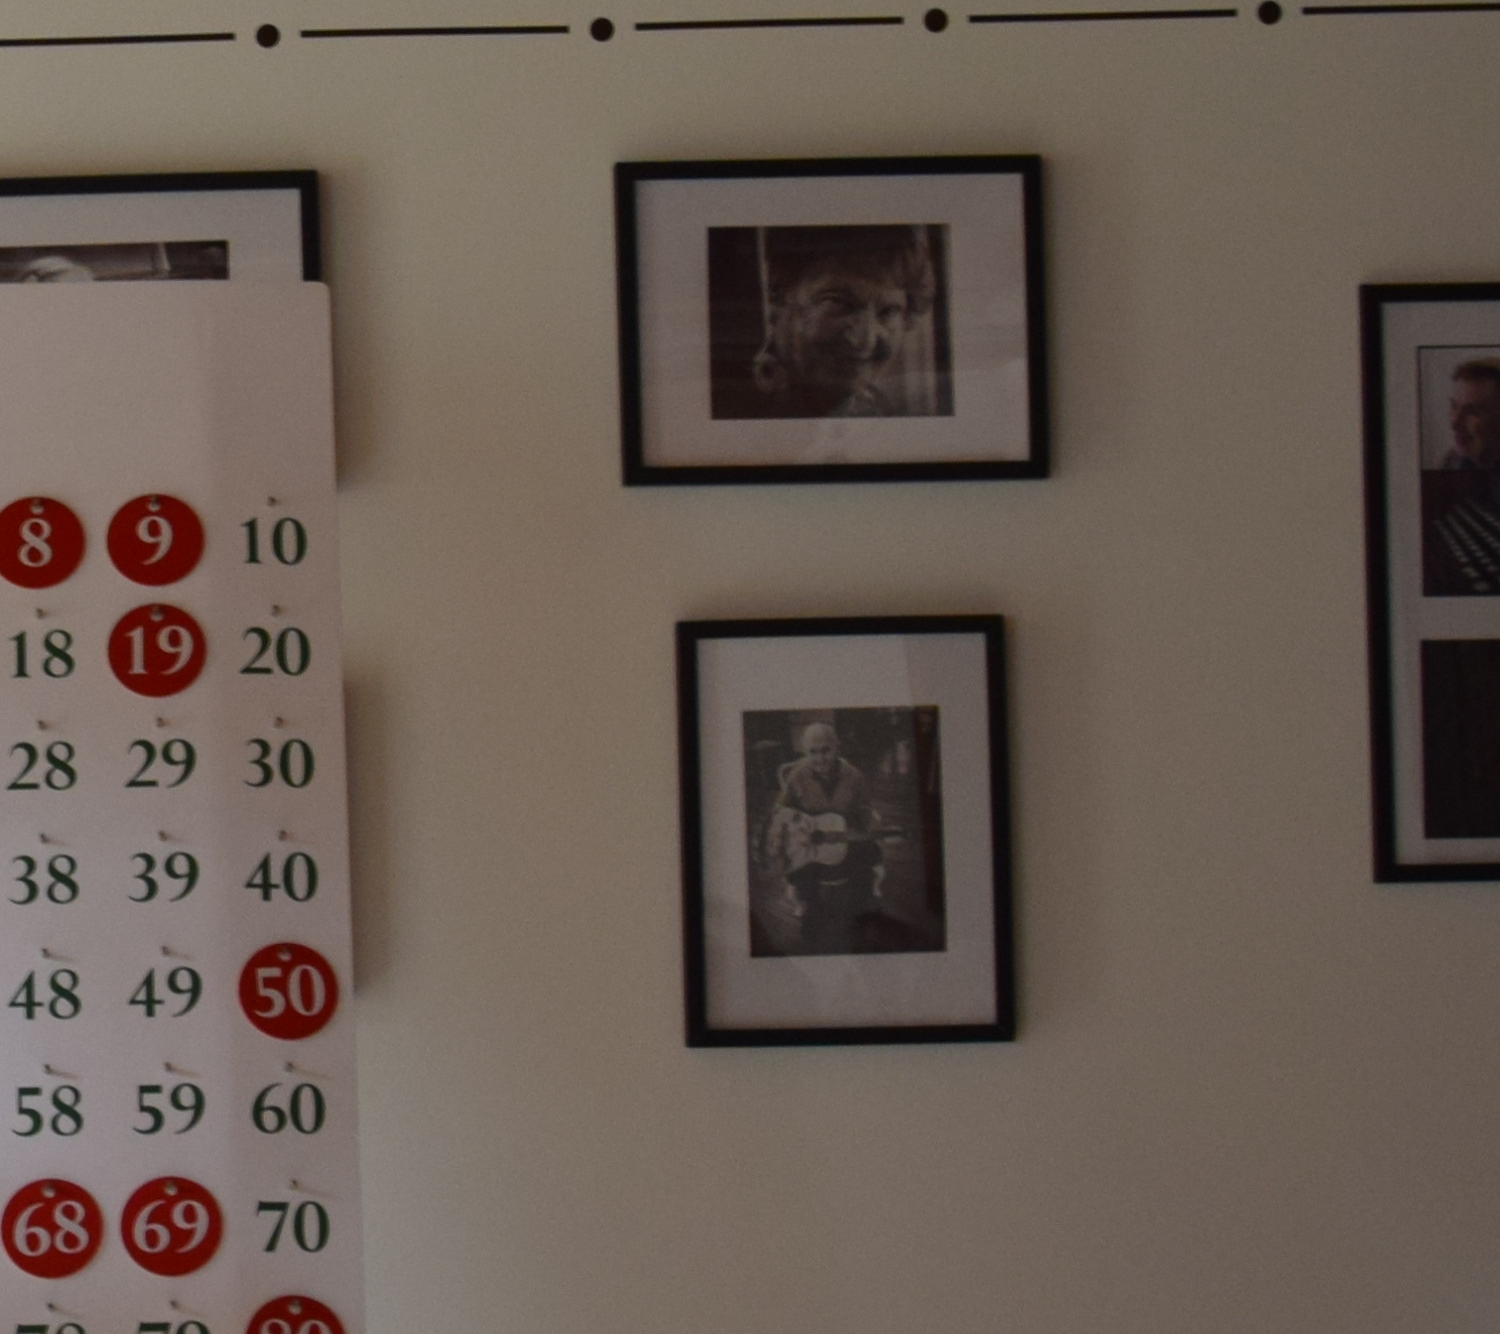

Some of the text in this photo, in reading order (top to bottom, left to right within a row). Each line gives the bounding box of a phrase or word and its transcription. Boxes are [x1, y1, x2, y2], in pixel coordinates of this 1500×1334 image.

[18, 518, 53, 568] 8
[136, 515, 173, 565] 9
[241, 517, 307, 566] 10
[9, 629, 75, 679] 18
[127, 625, 194, 675] 19
[240, 626, 311, 676] 20
[7, 741, 77, 791] 28
[125, 738, 197, 788] 29
[244, 738, 315, 789] 30
[9, 854, 79, 905] 38
[127, 851, 200, 903] 39
[245, 852, 319, 902] 40
[8, 968, 82, 1020] 48
[128, 966, 203, 1018] 49
[255, 964, 326, 1018] 50
[14, 1085, 84, 1137] 58
[134, 1082, 206, 1135] 59
[251, 1083, 326, 1135] 60
[13, 1200, 89, 1257] 68
[132, 1199, 210, 1253] 69
[257, 1200, 330, 1253] 70
